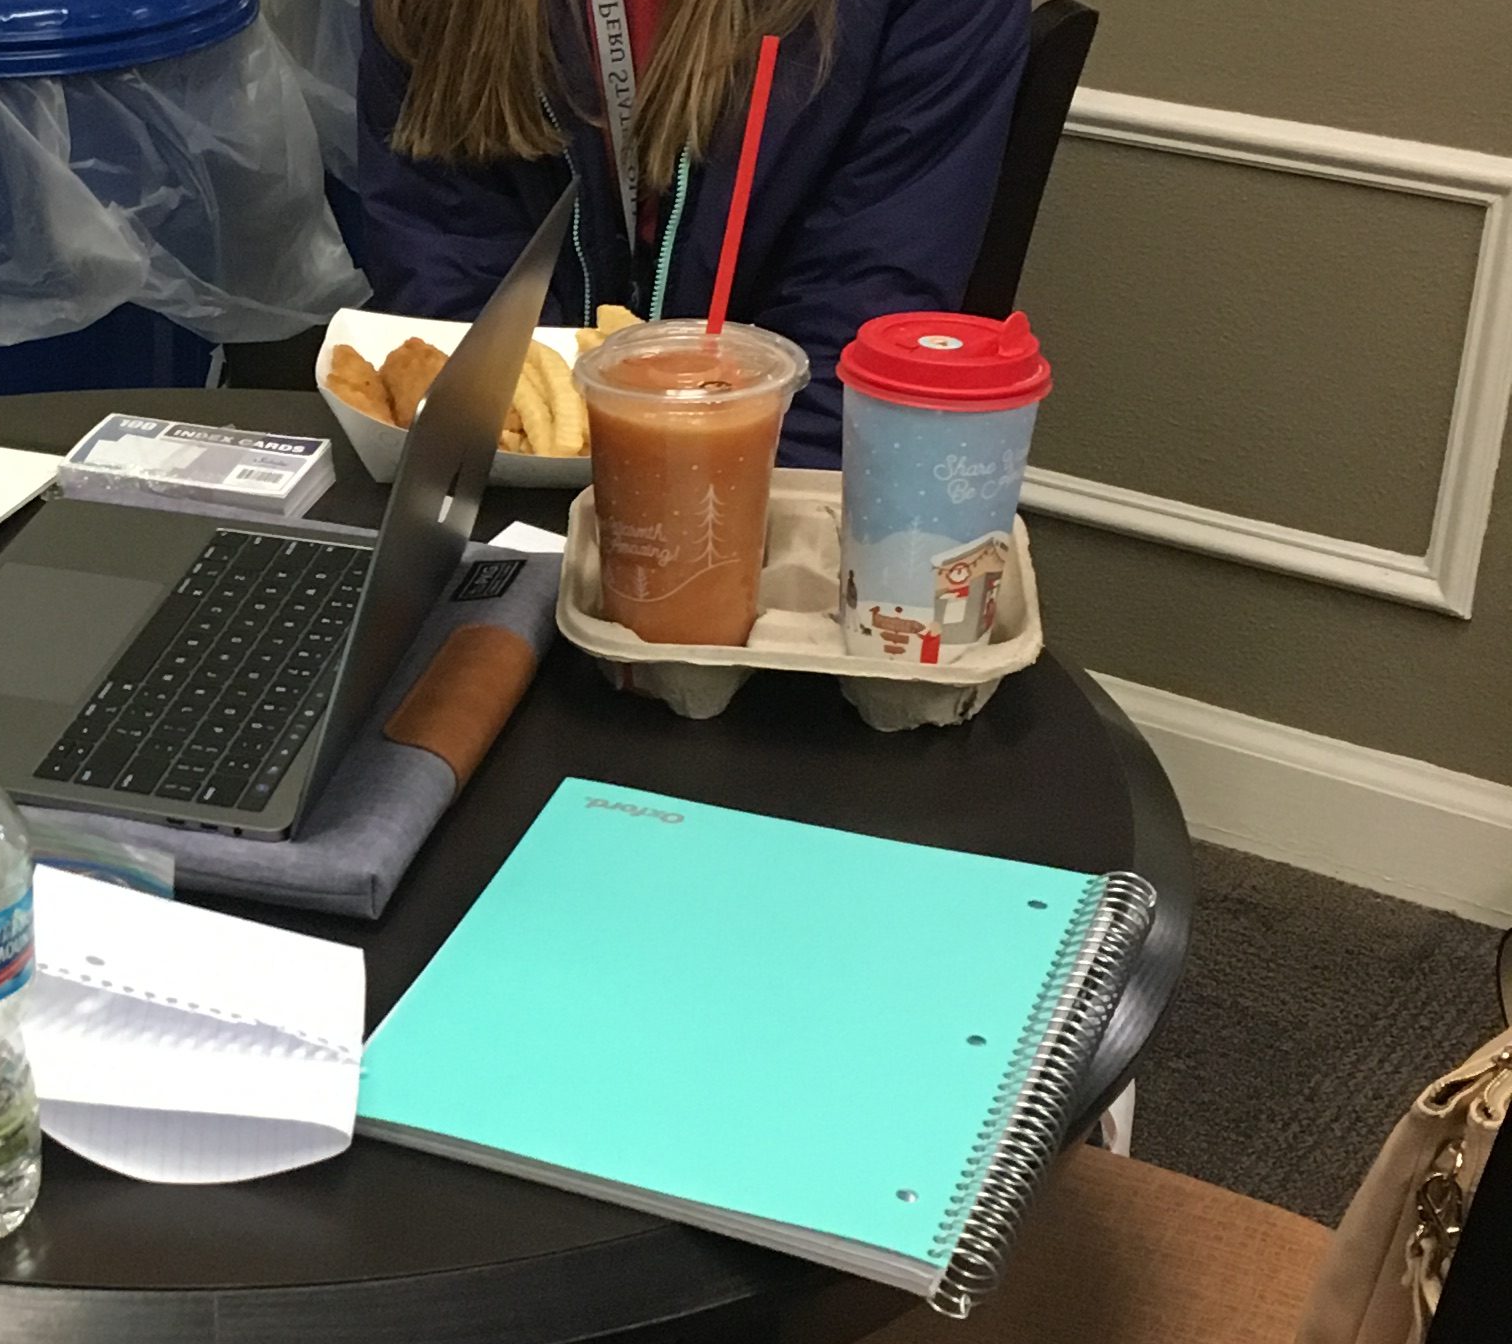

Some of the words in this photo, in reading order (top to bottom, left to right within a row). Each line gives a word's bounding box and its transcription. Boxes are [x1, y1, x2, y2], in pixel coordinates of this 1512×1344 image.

[119, 418, 159, 432] 100
[173, 429, 234, 444] INDEX
[238, 437, 307, 454] CARDS
[585, 798, 684, 823] Oxford
